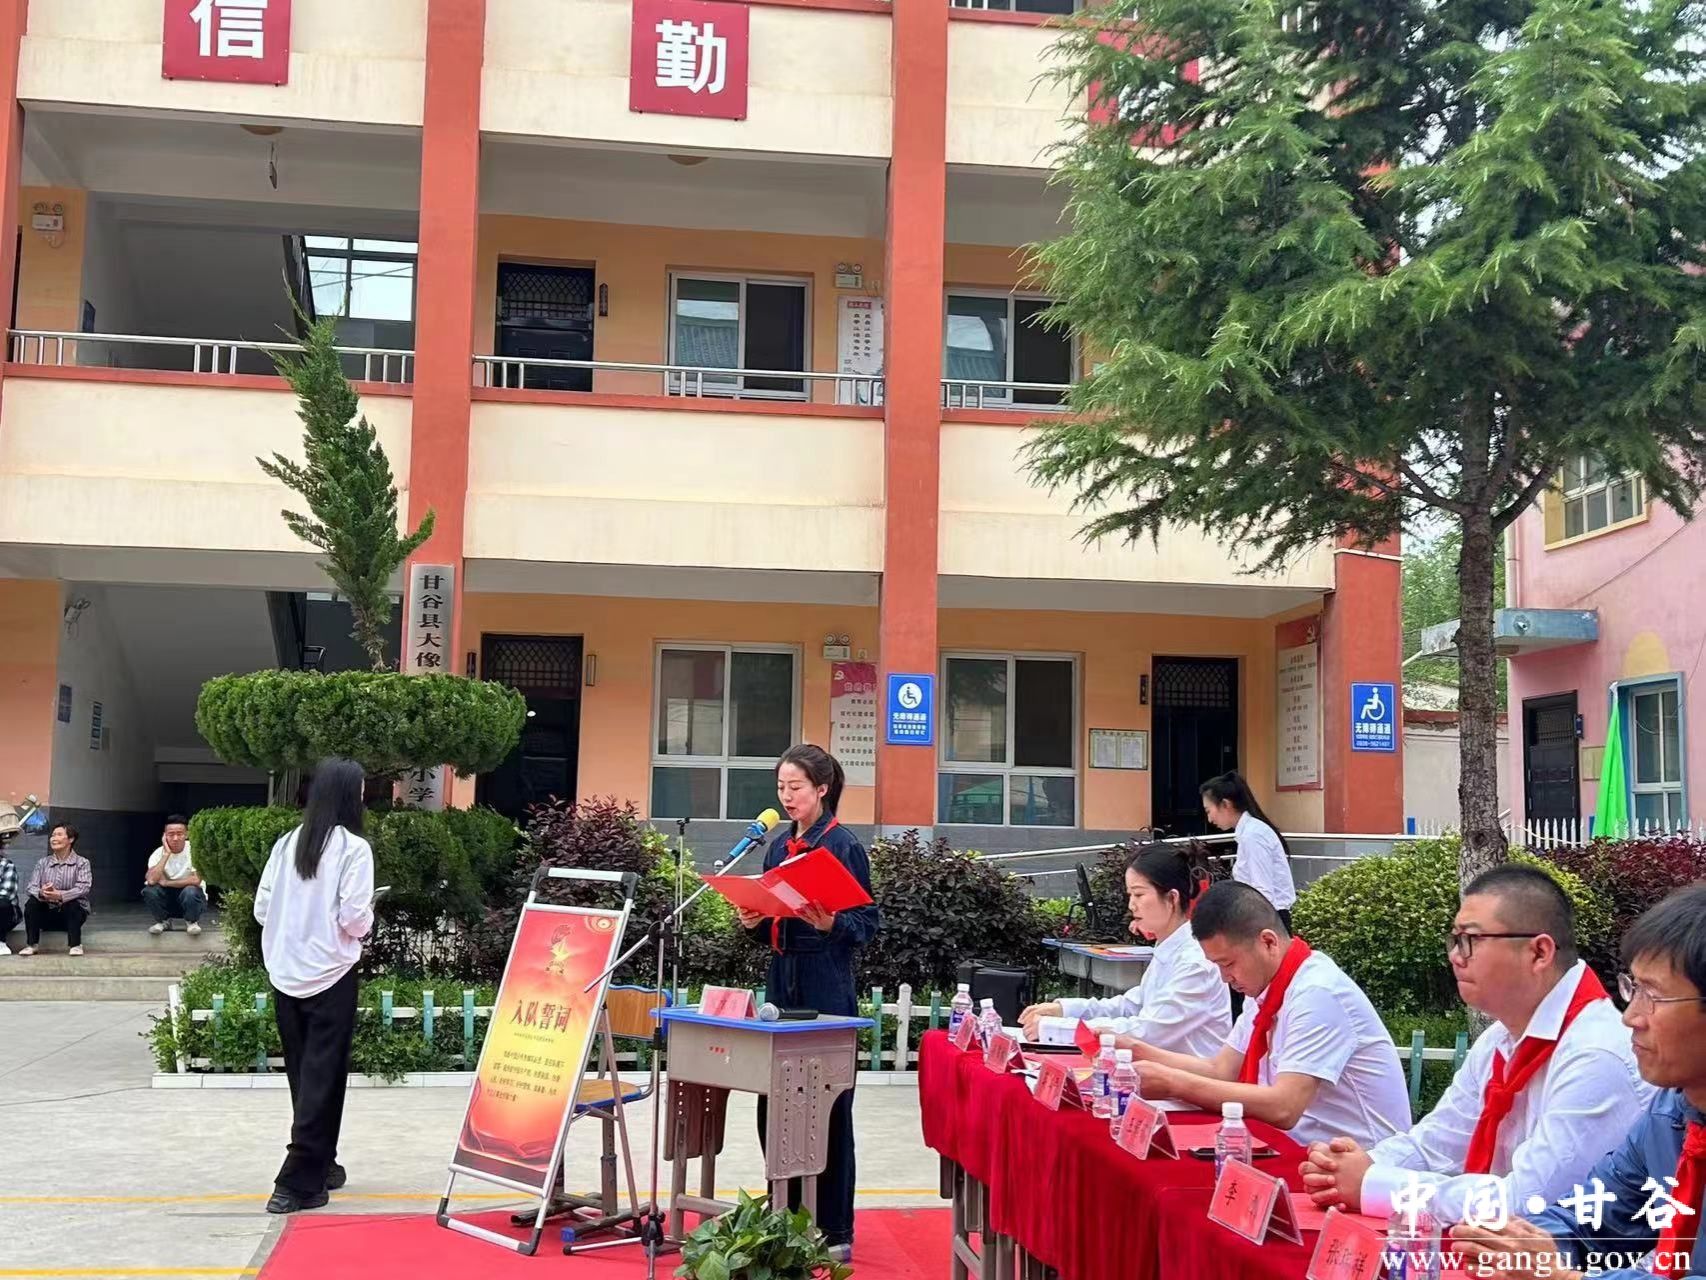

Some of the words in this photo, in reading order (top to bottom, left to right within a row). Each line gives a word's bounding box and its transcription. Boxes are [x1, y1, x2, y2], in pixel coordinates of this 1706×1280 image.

[189, 0, 268, 59] 信
[655, 19, 727, 94] 勤
[415, 574, 445, 668] 甘谷县大像
[511, 999, 572, 1033] 入队誓词
